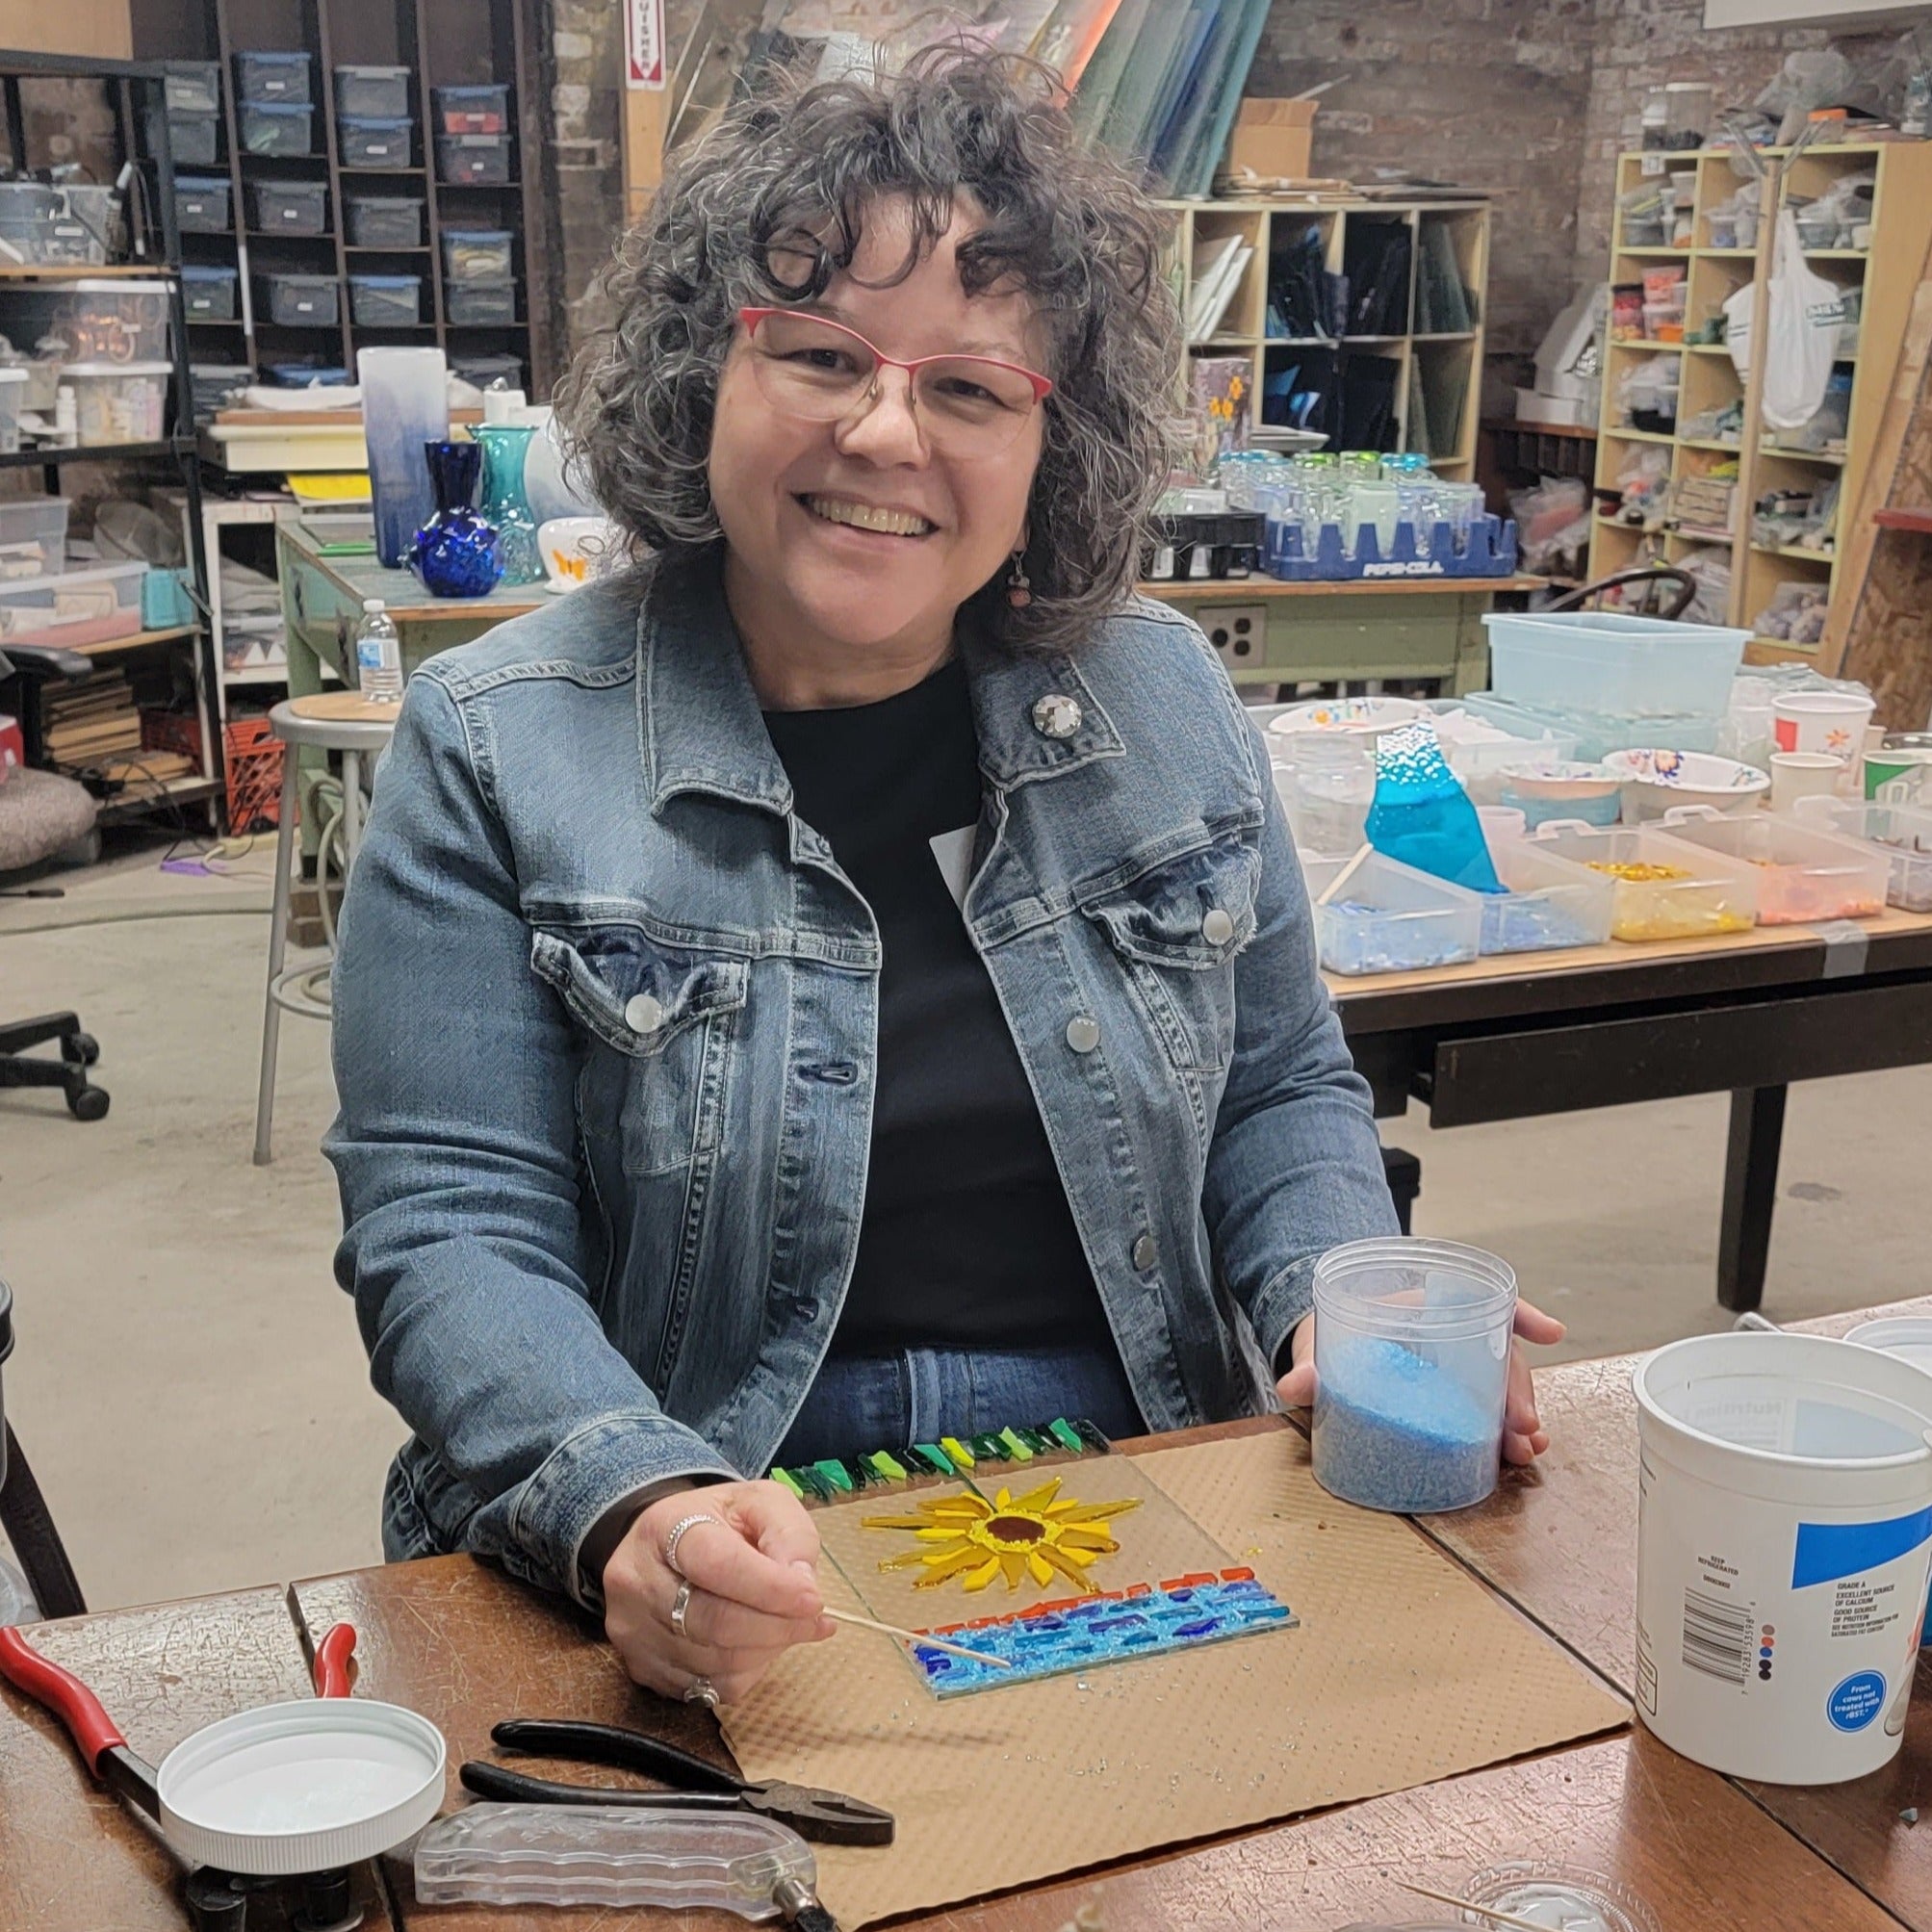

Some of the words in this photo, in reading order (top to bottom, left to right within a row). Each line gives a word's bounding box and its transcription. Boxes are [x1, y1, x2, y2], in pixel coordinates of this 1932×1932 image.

[1697, 1556, 1739, 1576] REFRIGERATED
[1836, 1589, 1871, 1599] EXCELLENT
[1872, 1584, 1894, 1595] SOURCE
[1844, 1597, 1873, 1606] CALCIUM
[1854, 1605, 1877, 1614] SOURCE
[1842, 1613, 1869, 1622] PROTEIN
[1850, 1685, 1871, 1693] From
[1842, 1694, 1863, 1703] cows
[1864, 1690, 1876, 1699] not
[1834, 1701, 1864, 1713] treated
[1865, 1697, 1880, 1707] with
